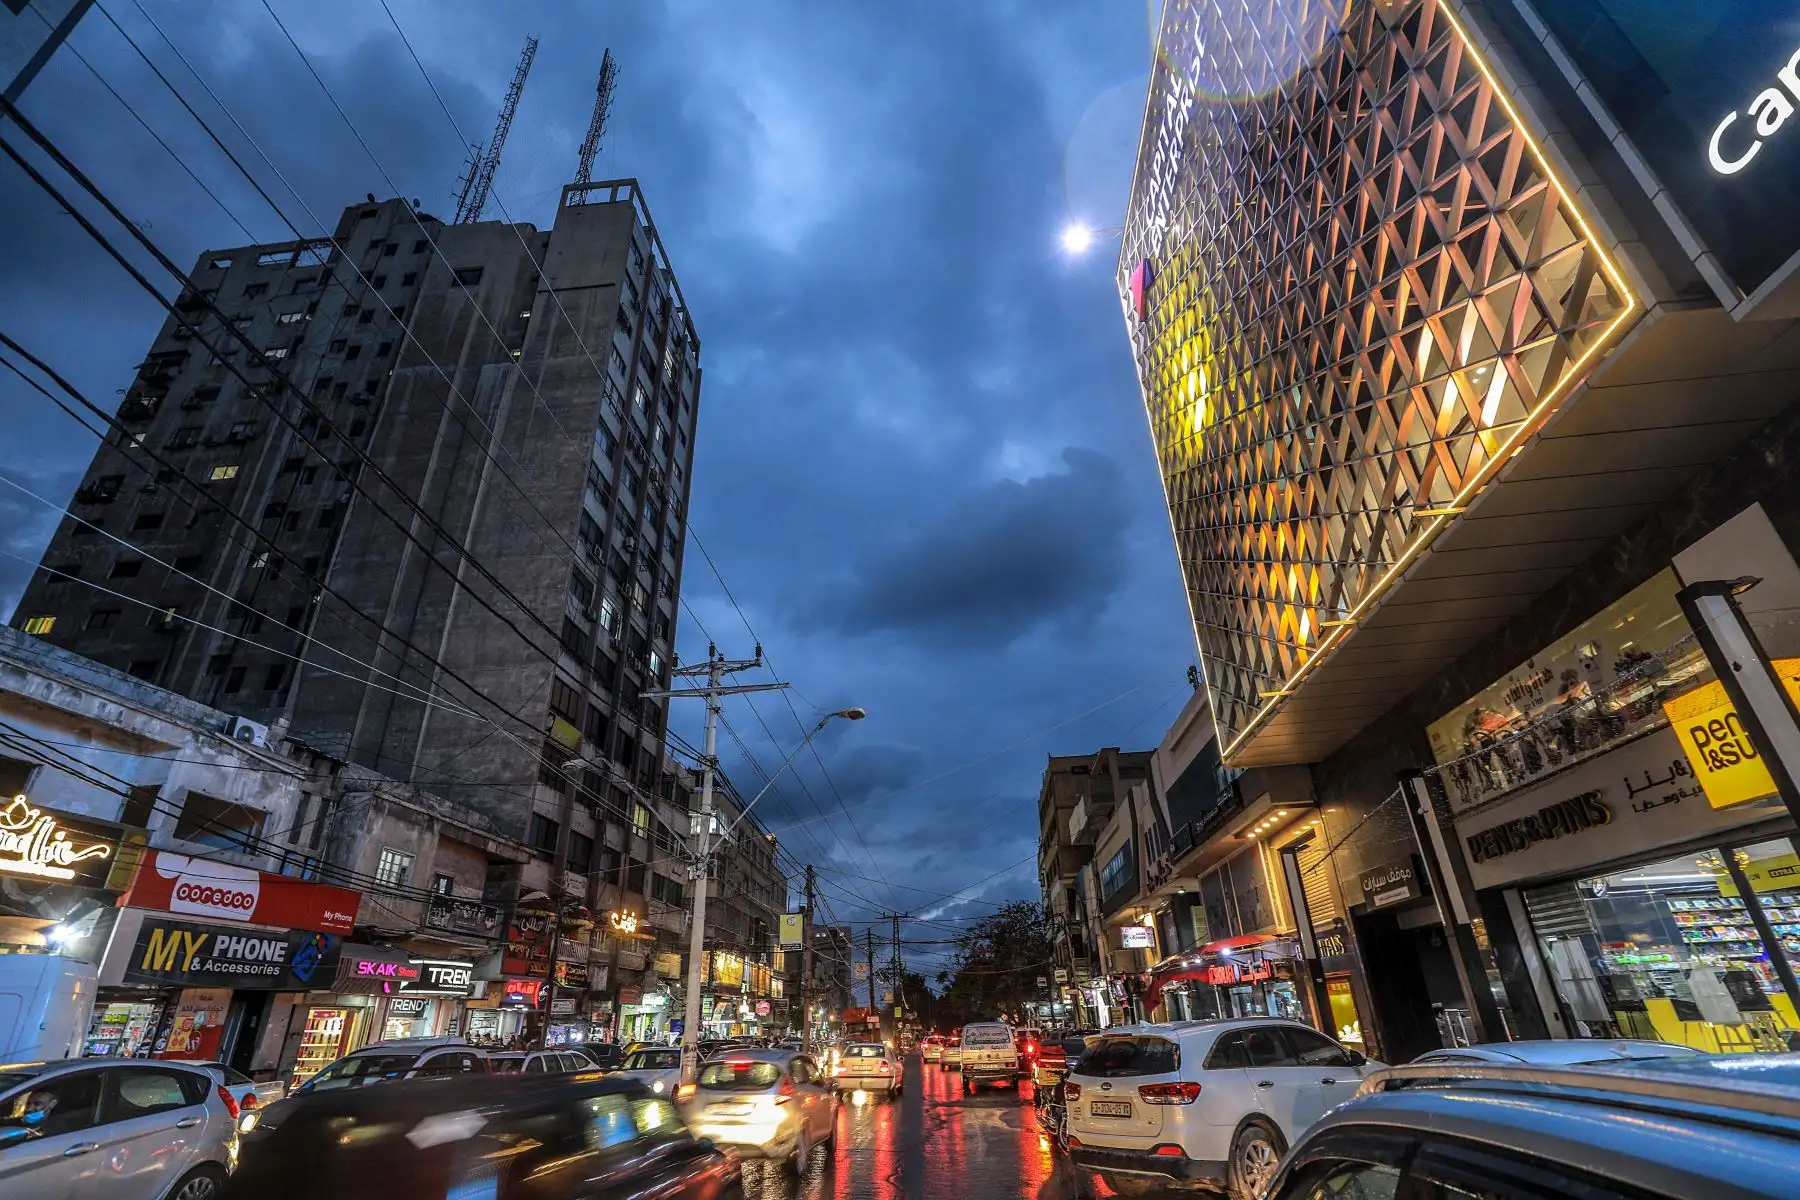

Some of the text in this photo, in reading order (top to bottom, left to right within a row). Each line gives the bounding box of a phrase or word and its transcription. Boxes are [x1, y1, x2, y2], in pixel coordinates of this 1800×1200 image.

[1145, 73, 1182, 228] CAPITAL
[1362, 867, 1412, 892] موقف سيارات
[178, 885, 253, 909] ooredoo
[141, 927, 289, 972] MY PHONE
[190, 957, 281, 976] & Accessories
[357, 961, 398, 977] SKAIK
